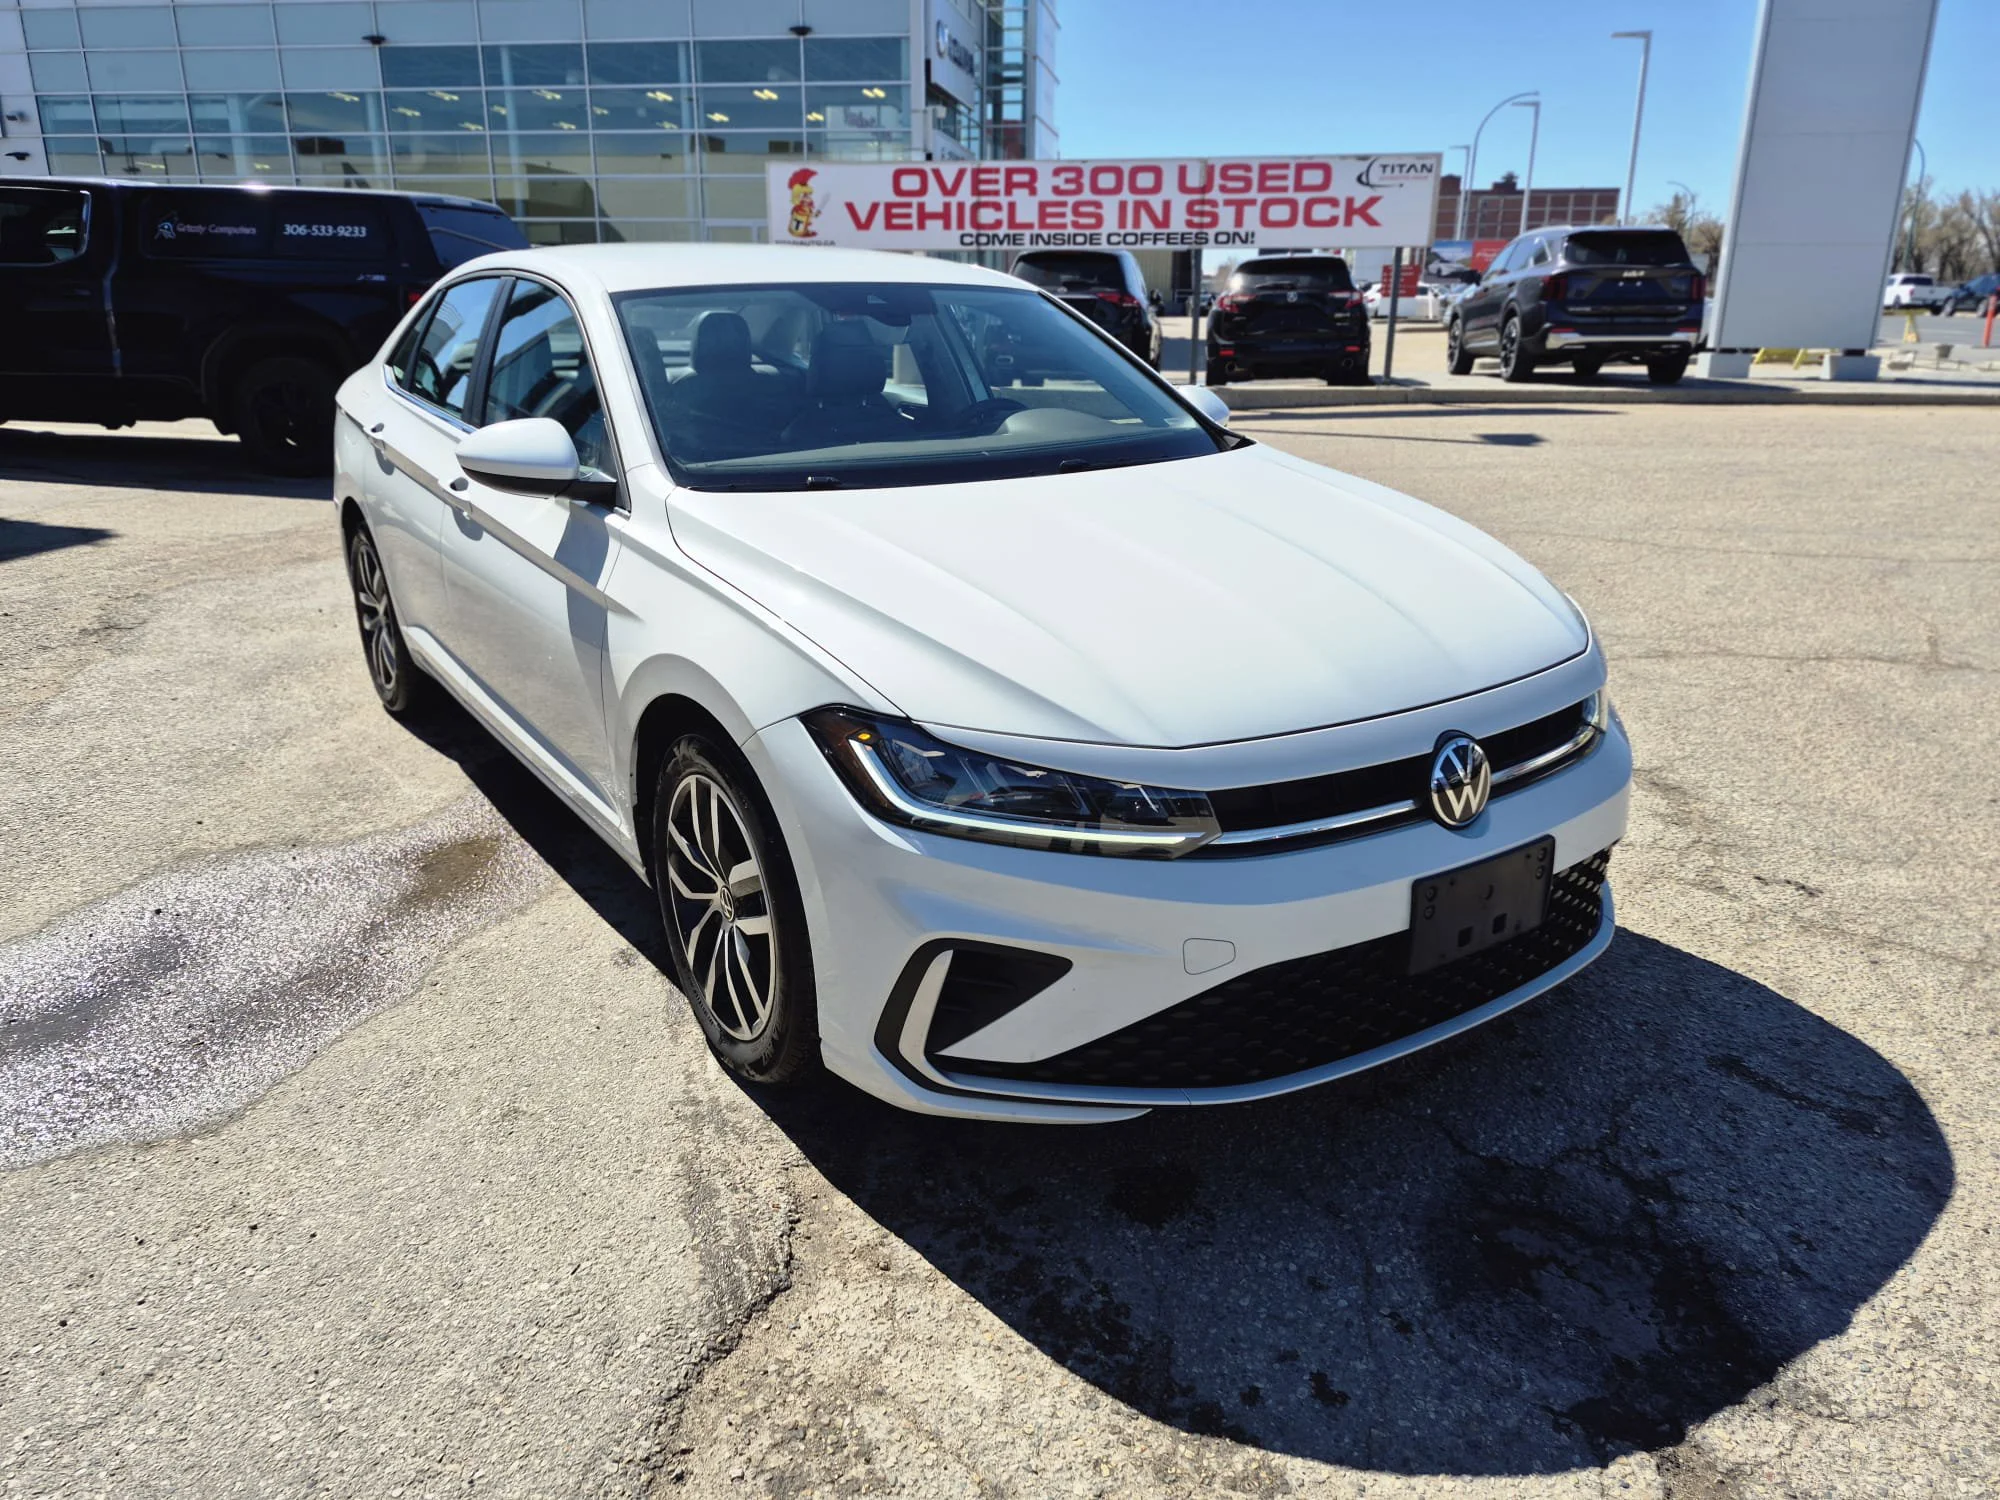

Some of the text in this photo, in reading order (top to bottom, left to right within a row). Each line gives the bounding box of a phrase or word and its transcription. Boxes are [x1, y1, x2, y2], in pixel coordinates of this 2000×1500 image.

[1379, 163, 1433, 175] TITAN
[892, 162, 1333, 197] OVER 300 USED
[844, 195, 1383, 231] VEHICLES IN STOCK
[283, 223, 367, 237] 306-533-9233
[959, 230, 1255, 247] COME INSIDE COFFEES ON!
